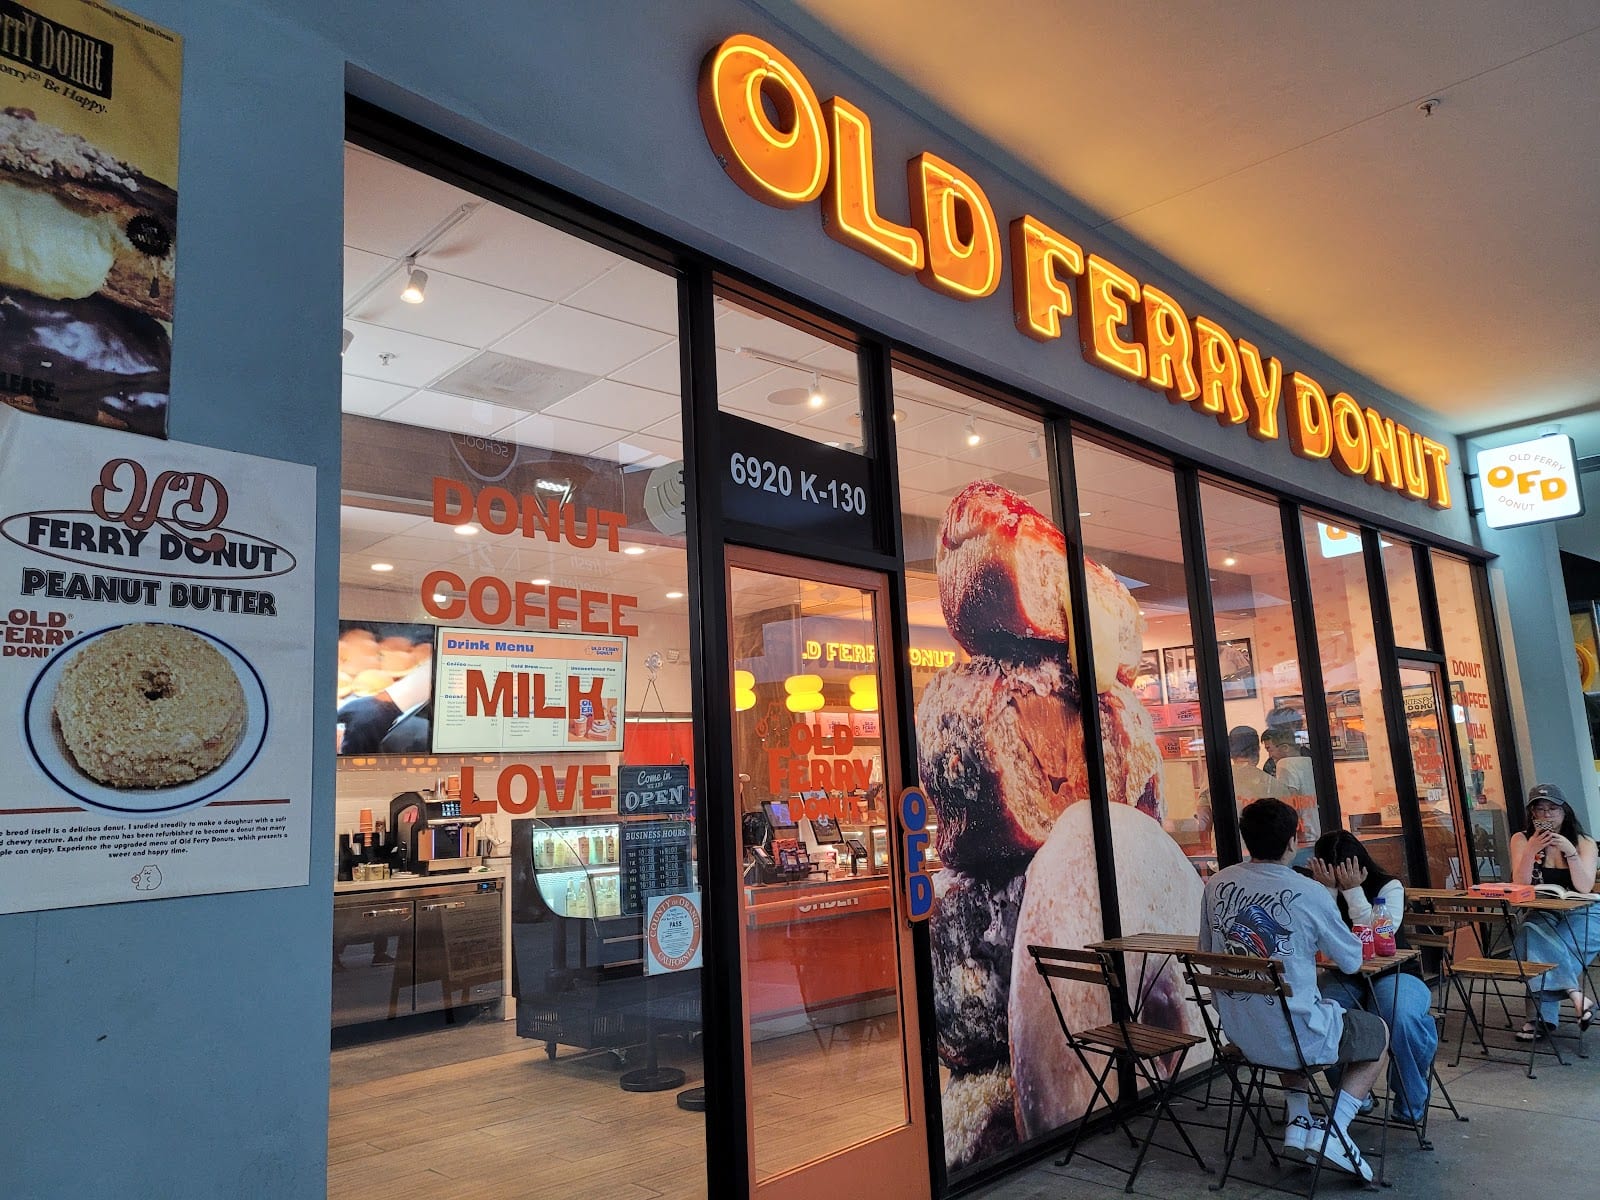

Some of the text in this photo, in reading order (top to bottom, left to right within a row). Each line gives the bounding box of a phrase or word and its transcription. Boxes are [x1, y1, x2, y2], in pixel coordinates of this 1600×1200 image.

[698, 34, 1452, 511] OLD FERRY DONUT
[1508, 453, 1566, 472] OLD FERRY
[730, 452, 866, 516] 6920 K-130
[1487, 465, 1568, 502] OFD
[1498, 495, 1535, 511] DONUT
[433, 477, 628, 553] DONUT
[28, 516, 277, 572] FERRY DONUT
[21, 567, 278, 616] PEANUT BUTTER
[421, 570, 639, 637] COFFEE
[8, 608, 67, 628] OLD
[0, 626, 84, 646] ERR
[447, 639, 535, 653] Drink Menu
[2, 645, 55, 659] DON
[826, 642, 876, 663] FERR
[909, 647, 956, 668] ONUT
[1452, 659, 1481, 679] DONUT
[466, 669, 605, 720] MILK
[1455, 690, 1489, 709] COFFEE
[789, 722, 853, 756] OLD
[637, 770, 672, 786] Come in
[768, 749, 873, 795] FERRY
[461, 764, 613, 815] LOVE
[625, 784, 685, 811] OPEN
[789, 796, 861, 822] DONUT
[31, 827, 51, 835] itself
[69, 826, 101, 834] delicious
[133, 822, 159, 830] studied
[160, 820, 187, 828] steadily
[255, 816, 268, 824] with
[625, 828, 687, 840] BUSINESS HOURS
[0, 849, 13, 857] ple
[57, 844, 98, 853] Experience
[114, 841, 147, 849] upgraded
[193, 837, 210, 845] Ferry
[7, 838, 32, 846] chewy
[35, 837, 65, 845] texture.
[136, 831, 154, 839] been
[155, 829, 194, 838] refurbished
[650, 899, 671, 938] COUNTY
[669, 920, 682, 928] PASS
[657, 948, 695, 967] CALIFORNIA
